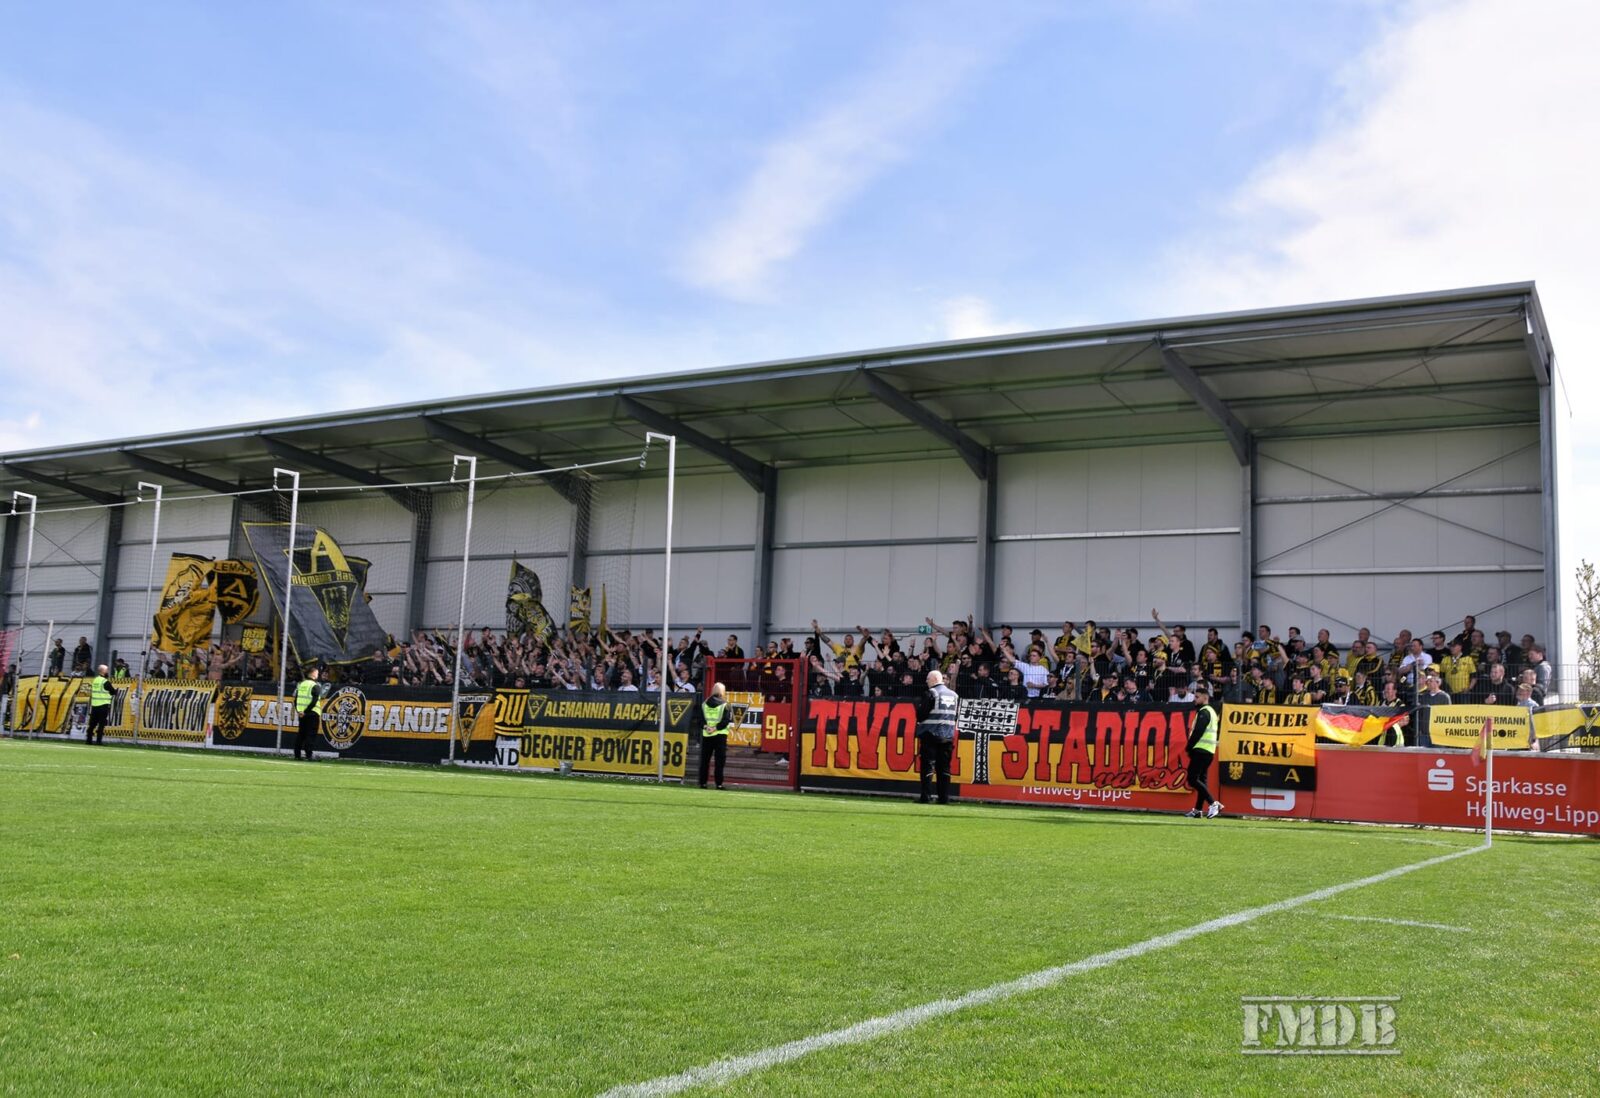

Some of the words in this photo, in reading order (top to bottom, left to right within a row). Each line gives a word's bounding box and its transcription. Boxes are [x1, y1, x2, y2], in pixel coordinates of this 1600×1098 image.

[249, 699, 300, 727] KAR
[368, 705, 450, 733] BANDE
[544, 701, 610, 719] ALEMANNIA
[614, 703, 661, 721] AACHE
[1228, 711, 1308, 727] OECHER
[1433, 715, 1462, 725] JULIAN
[1464, 715, 1526, 726] SCHWRMANN
[765, 715, 786, 739] 9a
[1445, 728, 1480, 737] FANCLUB
[809, 701, 961, 775] TIVO
[1567, 734, 1600, 747] Aache
[591, 737, 653, 766] POWER
[1237, 740, 1294, 759] KRAU
[1465, 776, 1567, 796] Sparkasse
[1467, 801, 1600, 826] Hellweg-Lipp
